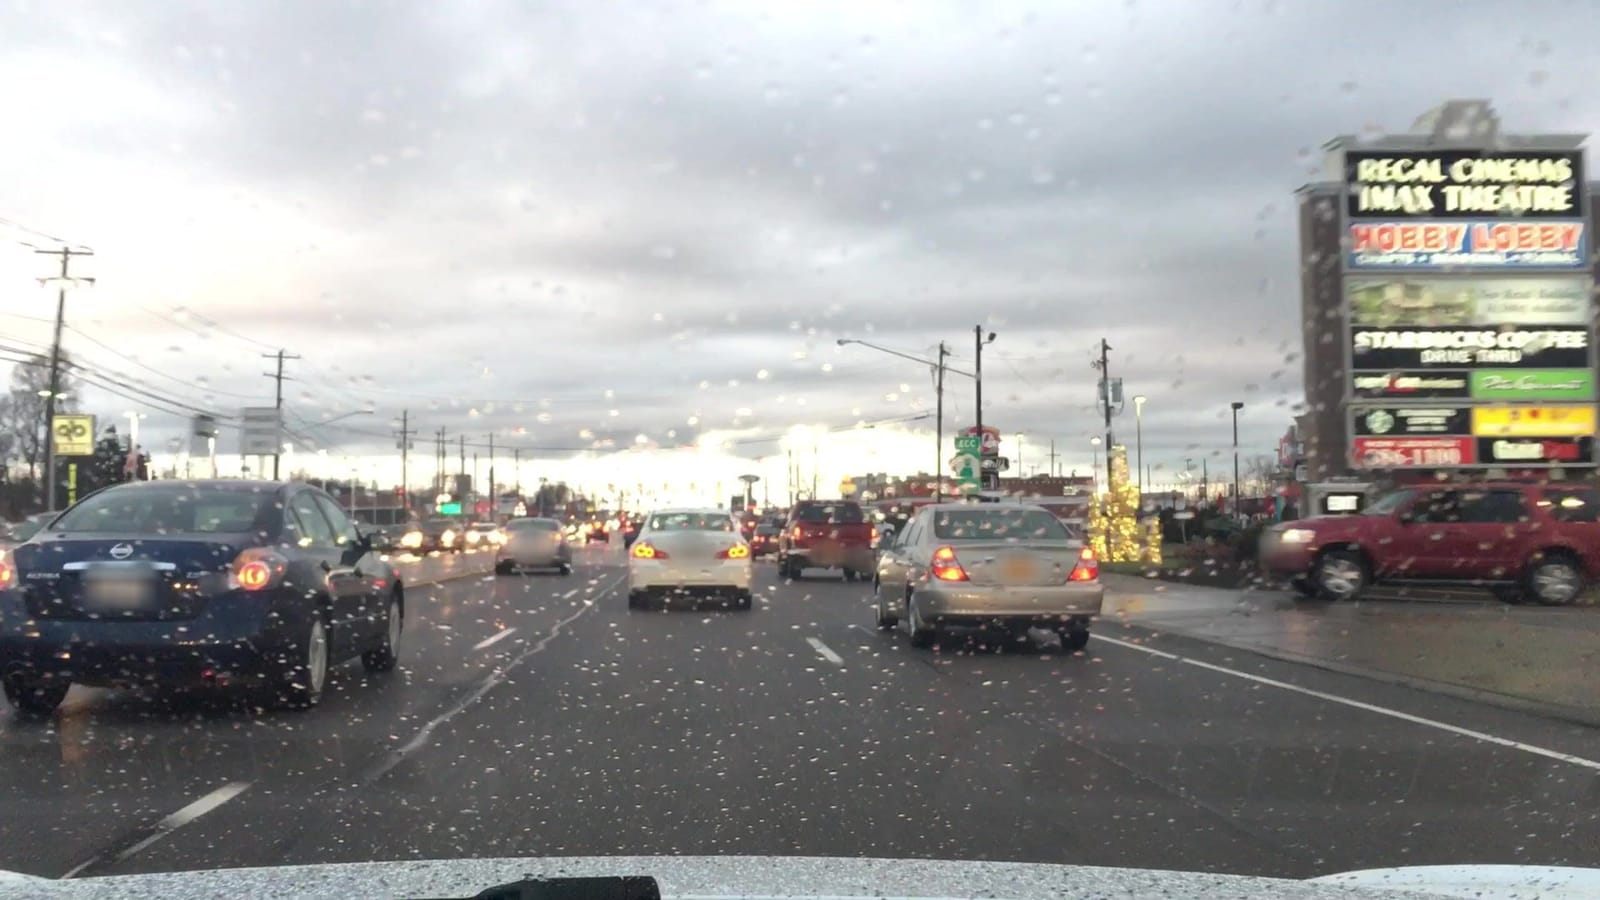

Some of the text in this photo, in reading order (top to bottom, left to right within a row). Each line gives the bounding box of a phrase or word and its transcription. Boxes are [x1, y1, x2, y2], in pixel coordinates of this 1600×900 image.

[1358, 158, 1573, 184] REGAL CINEMAS
[1357, 185, 1573, 212] IMAX THEATRE
[1351, 223, 1584, 253] HOBBY LOBBY
[1354, 331, 1497, 349] STARBUCKS
